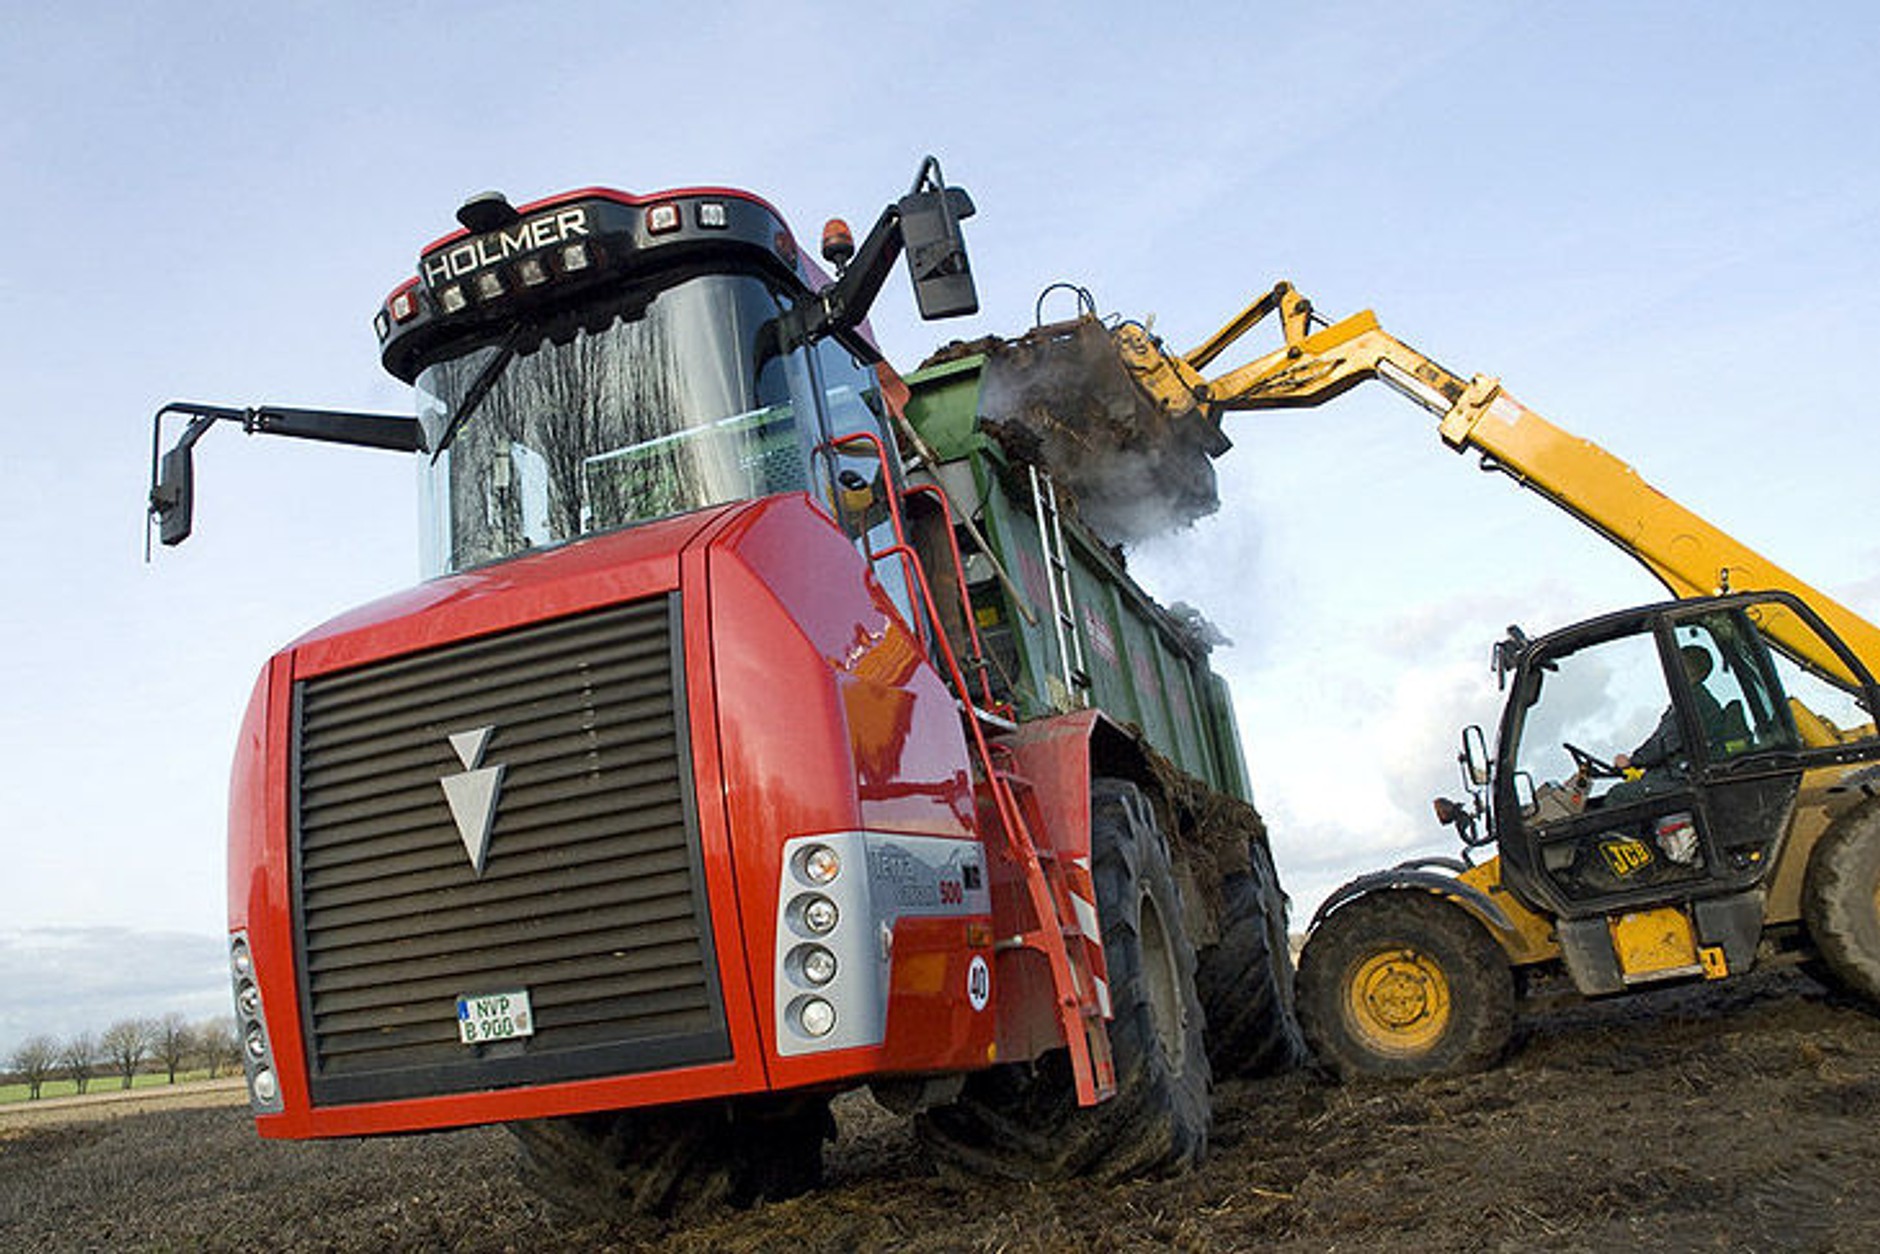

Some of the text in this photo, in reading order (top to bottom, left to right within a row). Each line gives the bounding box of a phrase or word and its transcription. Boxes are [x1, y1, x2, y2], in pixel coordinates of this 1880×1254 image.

[425, 208, 589, 287] HOLMER
[1608, 842, 1649, 874] JCB
[477, 997, 509, 1017] NVP
[464, 1017, 514, 1041] B 900
